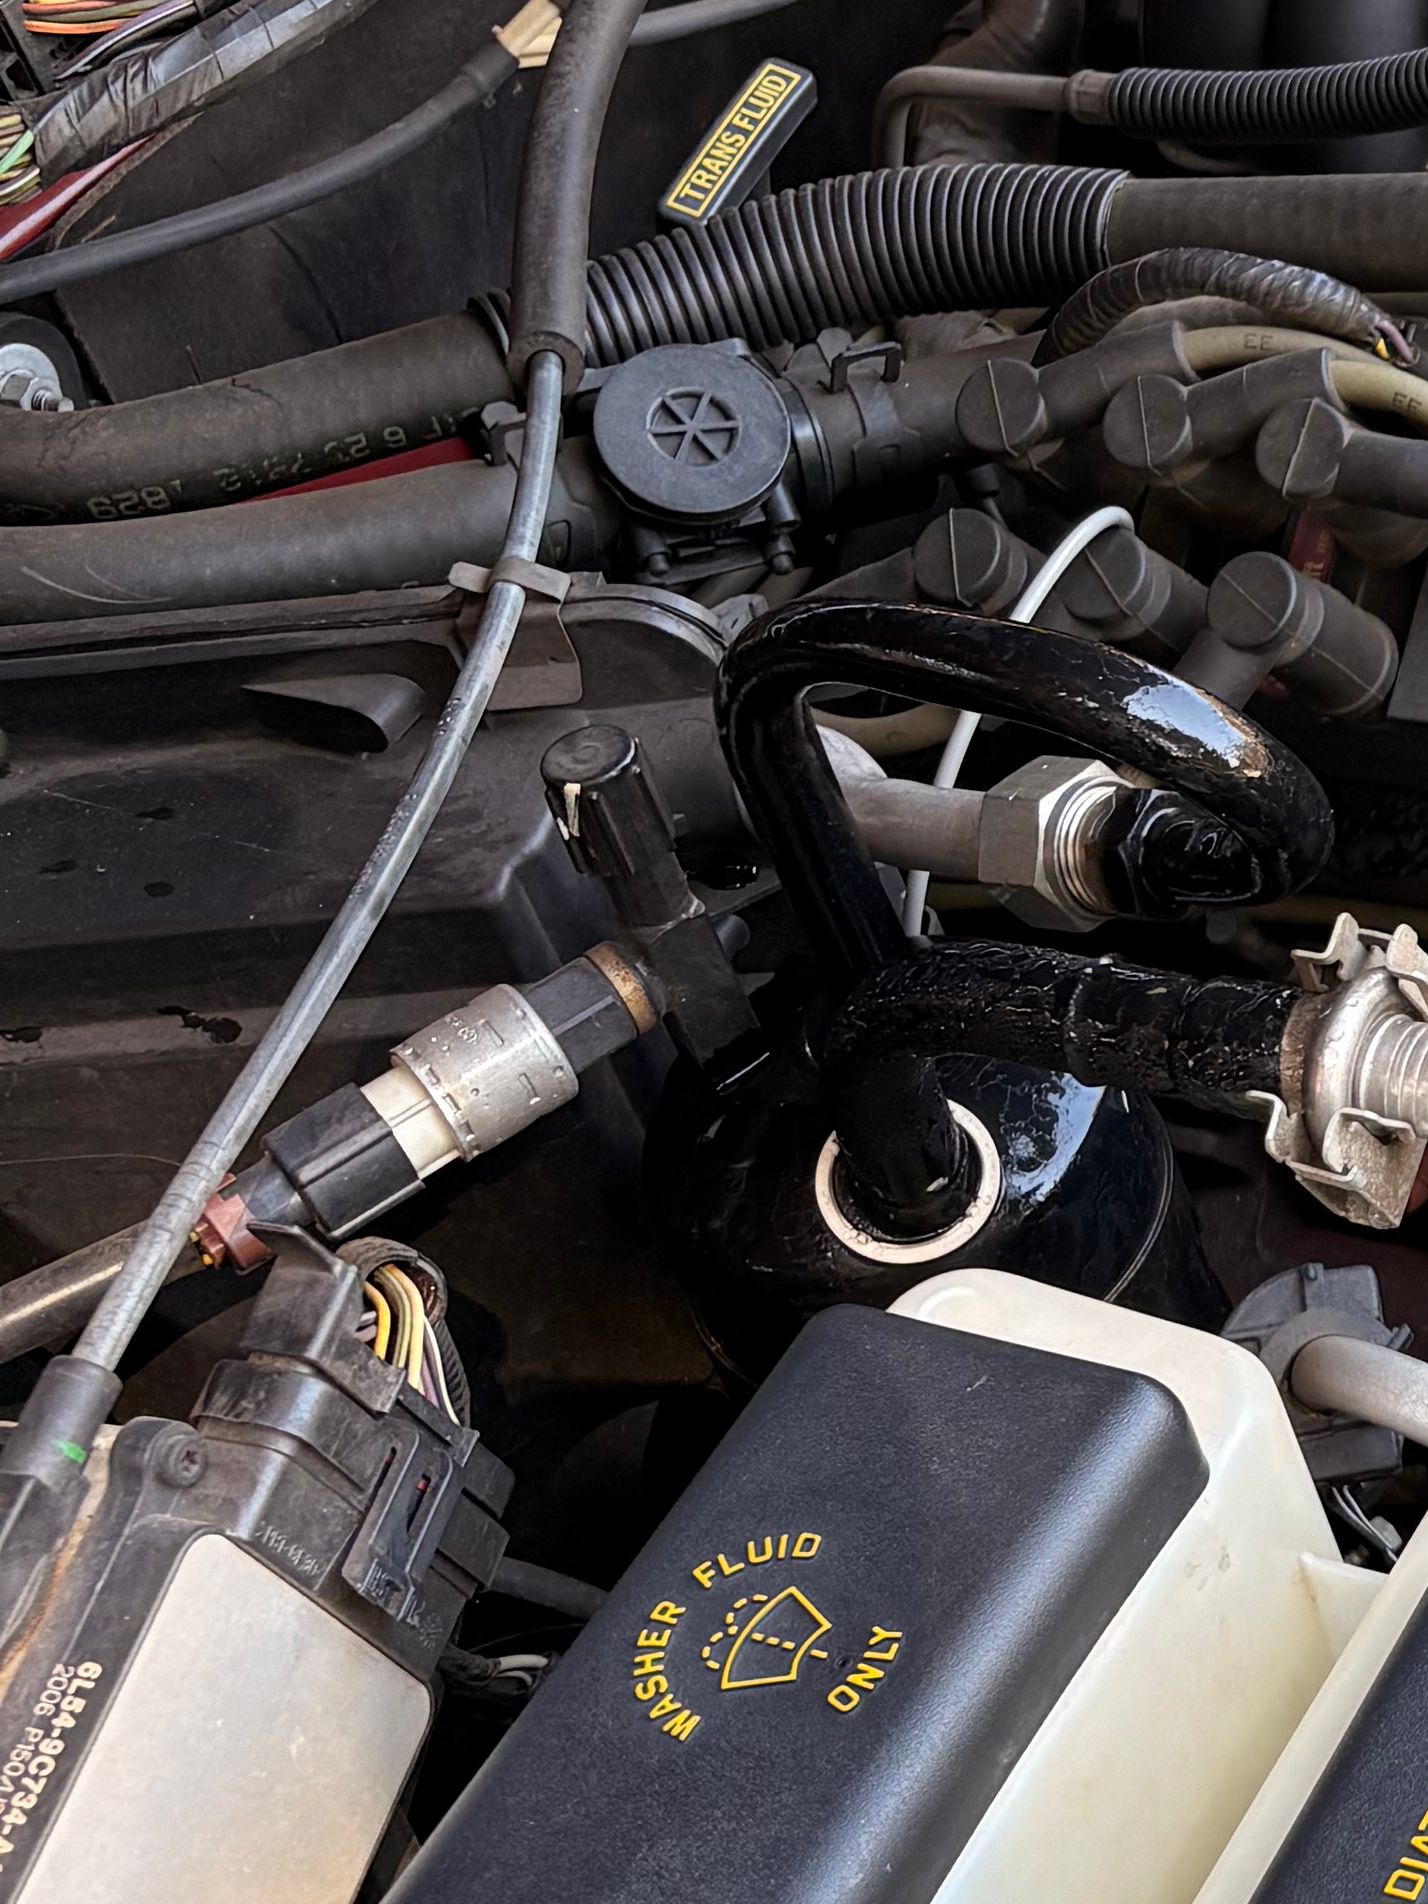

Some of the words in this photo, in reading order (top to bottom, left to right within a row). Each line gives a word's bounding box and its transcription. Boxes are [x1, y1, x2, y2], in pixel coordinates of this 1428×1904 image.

[681, 131, 750, 203] TRANS
[732, 69, 795, 133] FLUID
[691, 1531, 824, 1590] FLUID
[633, 1599, 702, 1744] WASHER
[826, 1624, 904, 1716] ONLY
